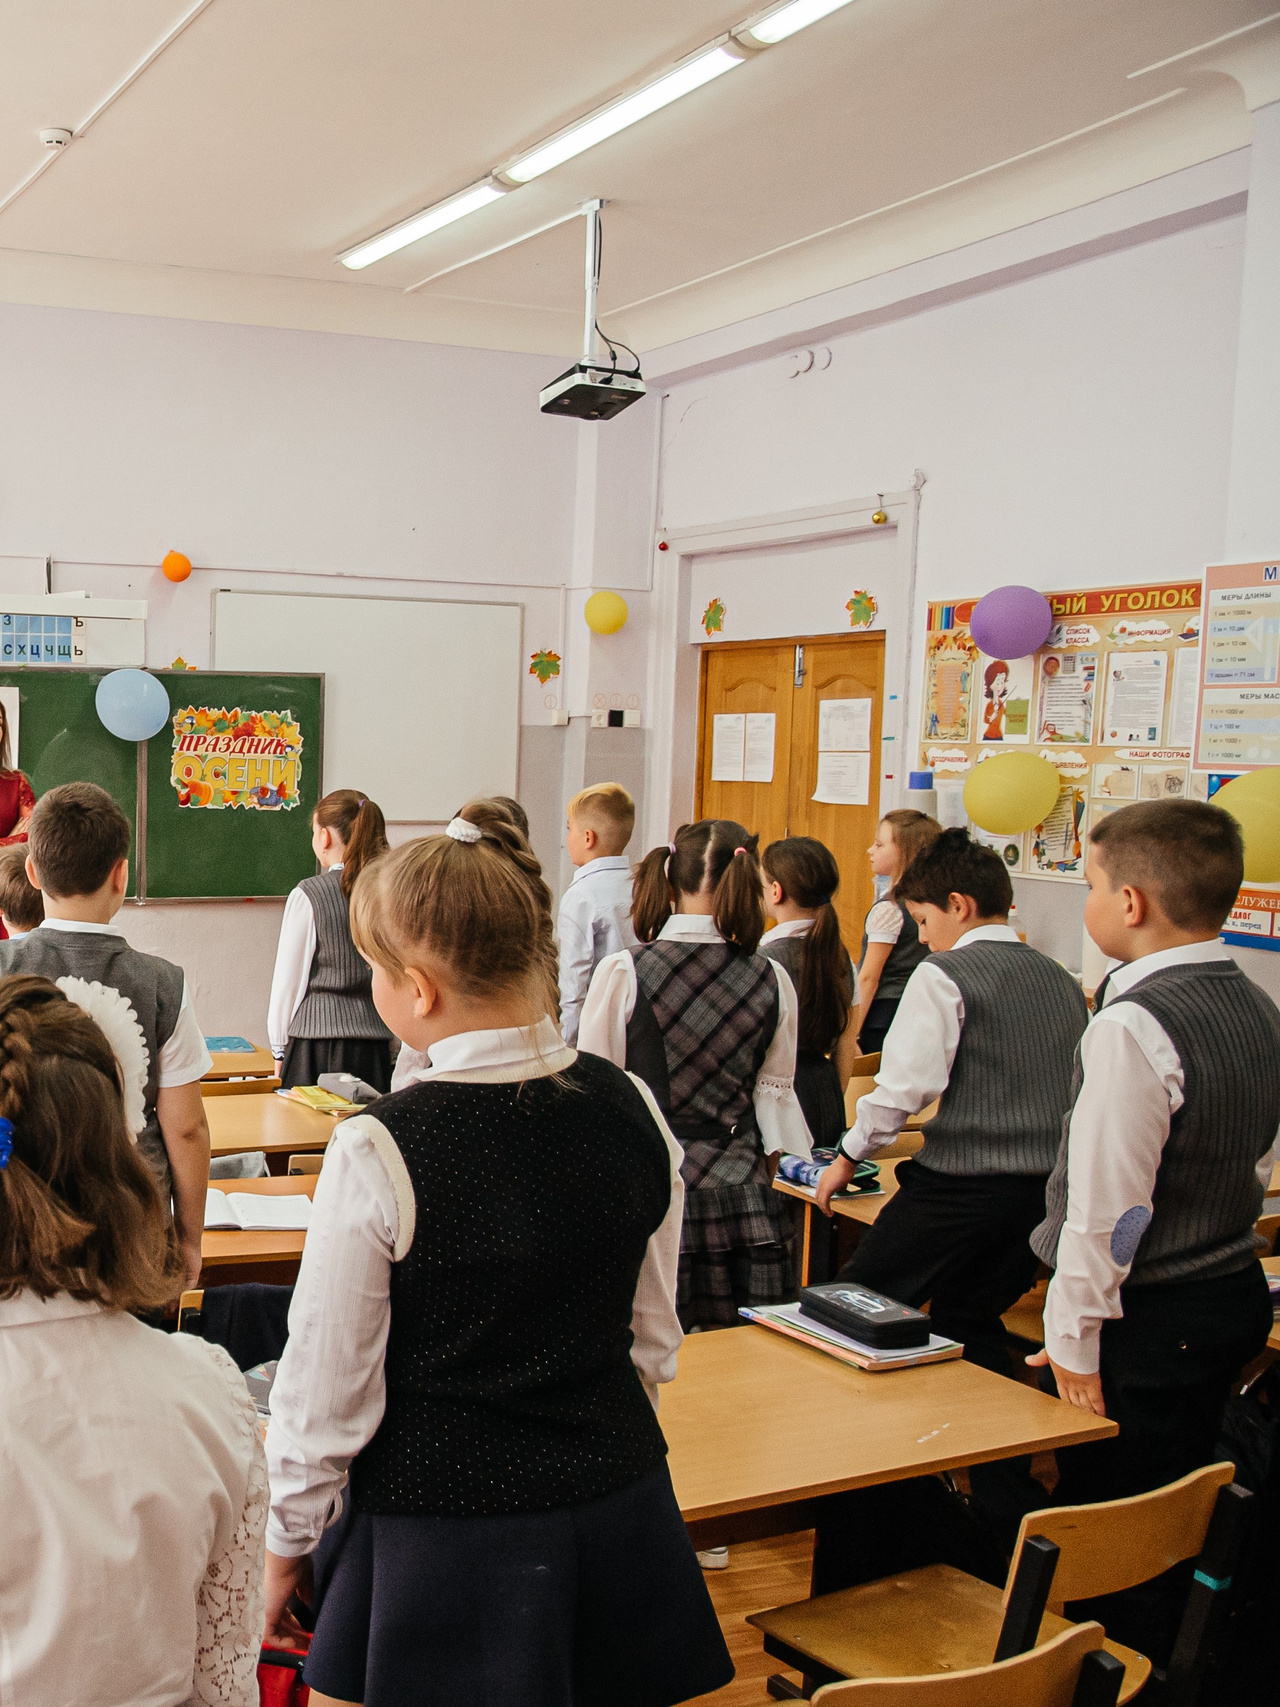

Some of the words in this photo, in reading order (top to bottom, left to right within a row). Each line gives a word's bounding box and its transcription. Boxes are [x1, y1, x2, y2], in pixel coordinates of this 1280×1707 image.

[1244, 592, 1271, 600] ДЛИНЫ
[1052, 592, 1086, 615] ЫЙ
[1100, 588, 1196, 612] УГОЛОК
[1127, 628, 1171, 638] ИНФОРМАЦИЯ
[1065, 636, 1090, 644] КЛАССА
[178, 734, 288, 757] ПРАЗДНИК
[174, 755, 296, 792] ОСЕНИ
[1240, 921, 1261, 930] перед
